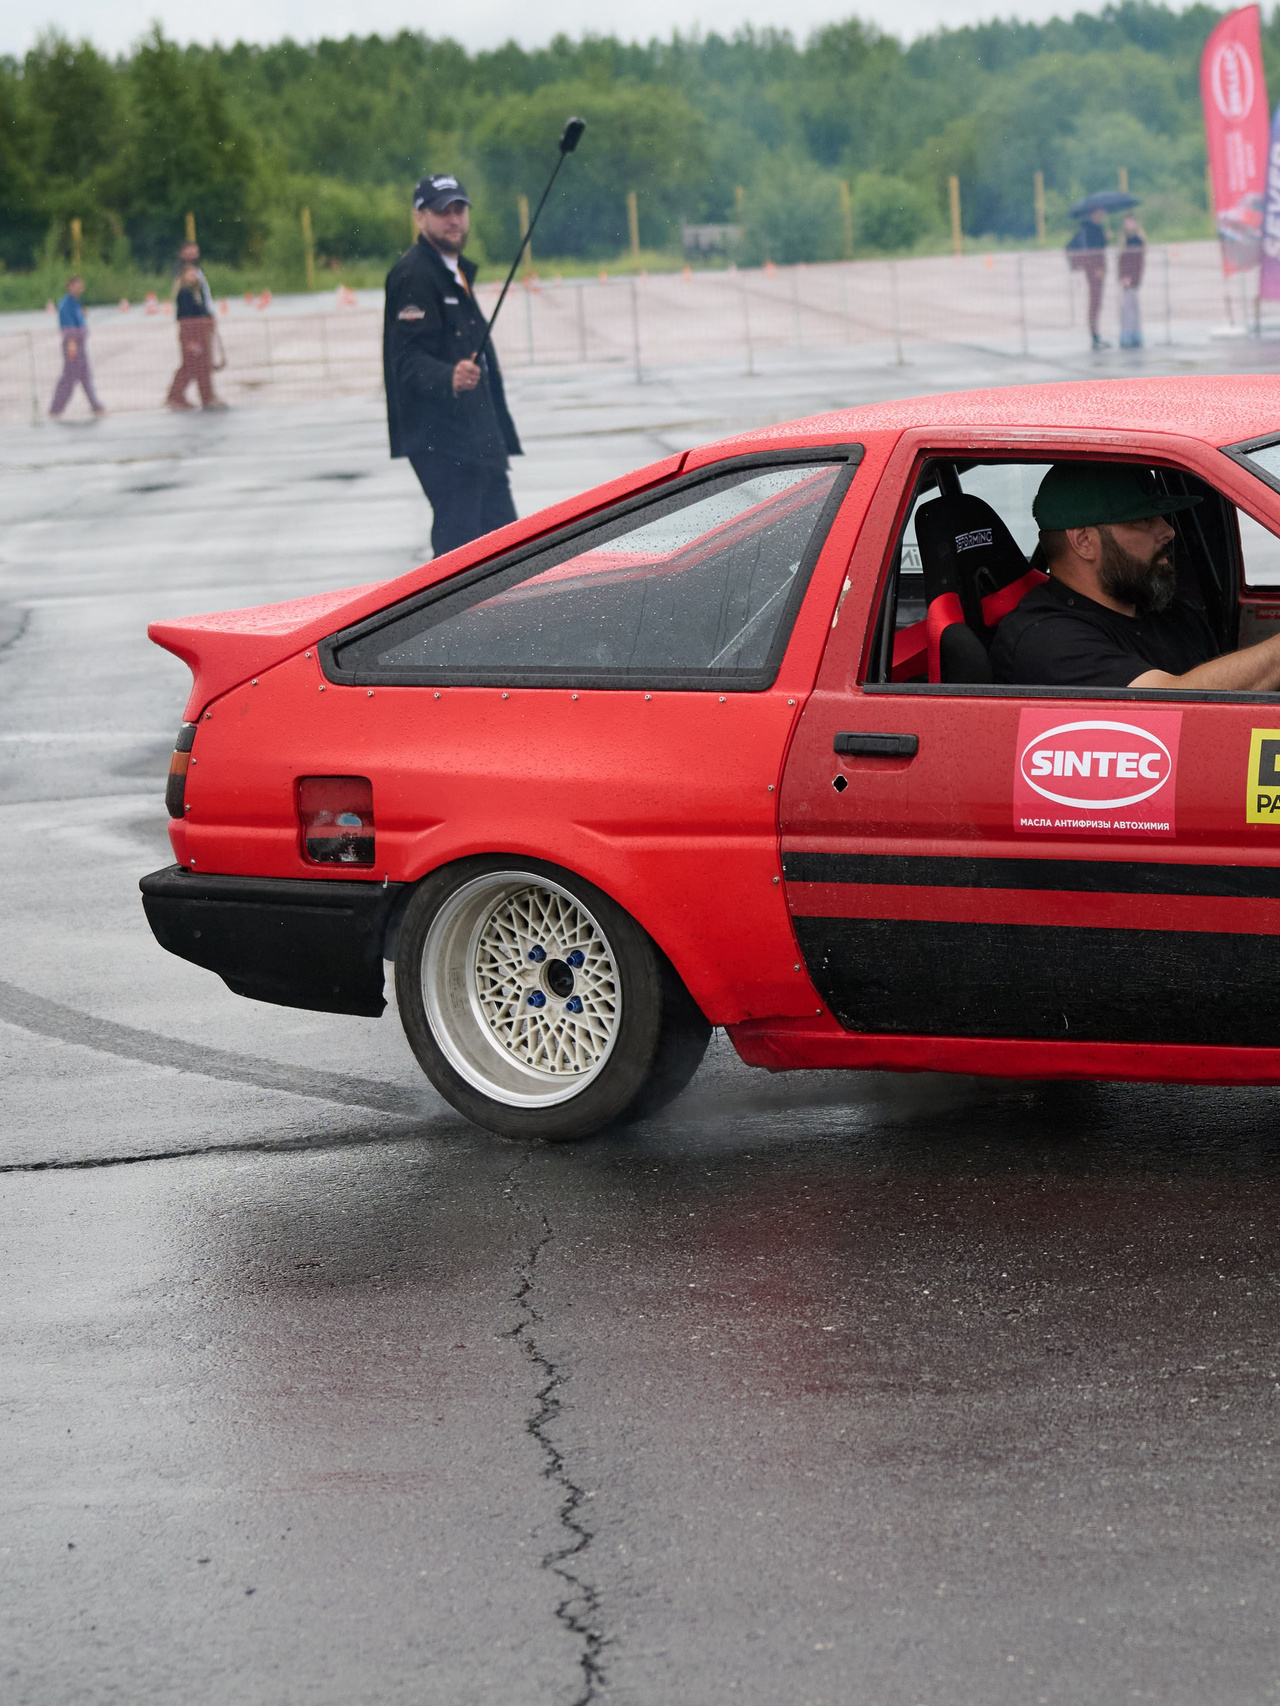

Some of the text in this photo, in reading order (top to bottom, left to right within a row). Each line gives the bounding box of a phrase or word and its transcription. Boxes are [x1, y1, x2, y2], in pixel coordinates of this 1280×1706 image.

[1030, 750, 1161, 779] SINTEC
[1020, 818, 1170, 831] МАСЛА АНТИФРИЗЫ АВТОХИМИЯ
